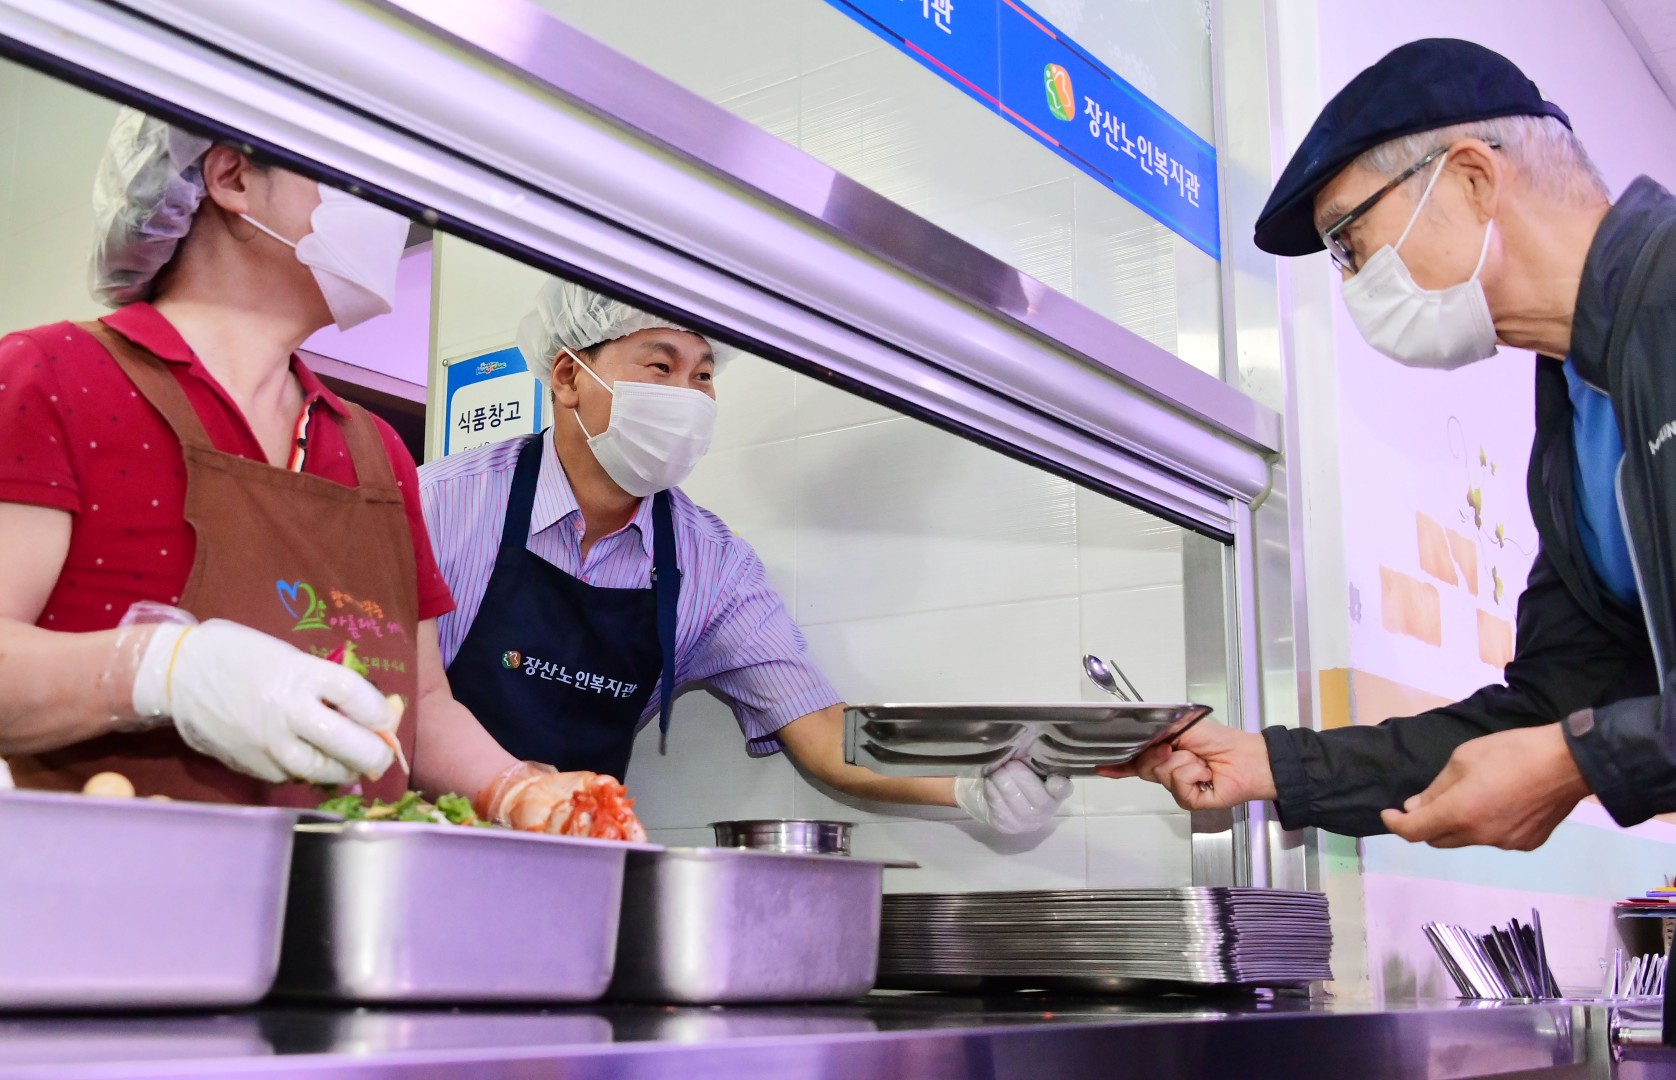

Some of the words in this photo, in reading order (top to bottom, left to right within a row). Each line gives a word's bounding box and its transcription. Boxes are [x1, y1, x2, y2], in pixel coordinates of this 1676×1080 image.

[920, 0, 952, 35] 관
[1084, 95, 1200, 208] 장산노인복지관
[458, 401, 521, 434] 식품창고
[523, 656, 637, 698] 장산노인복지관
